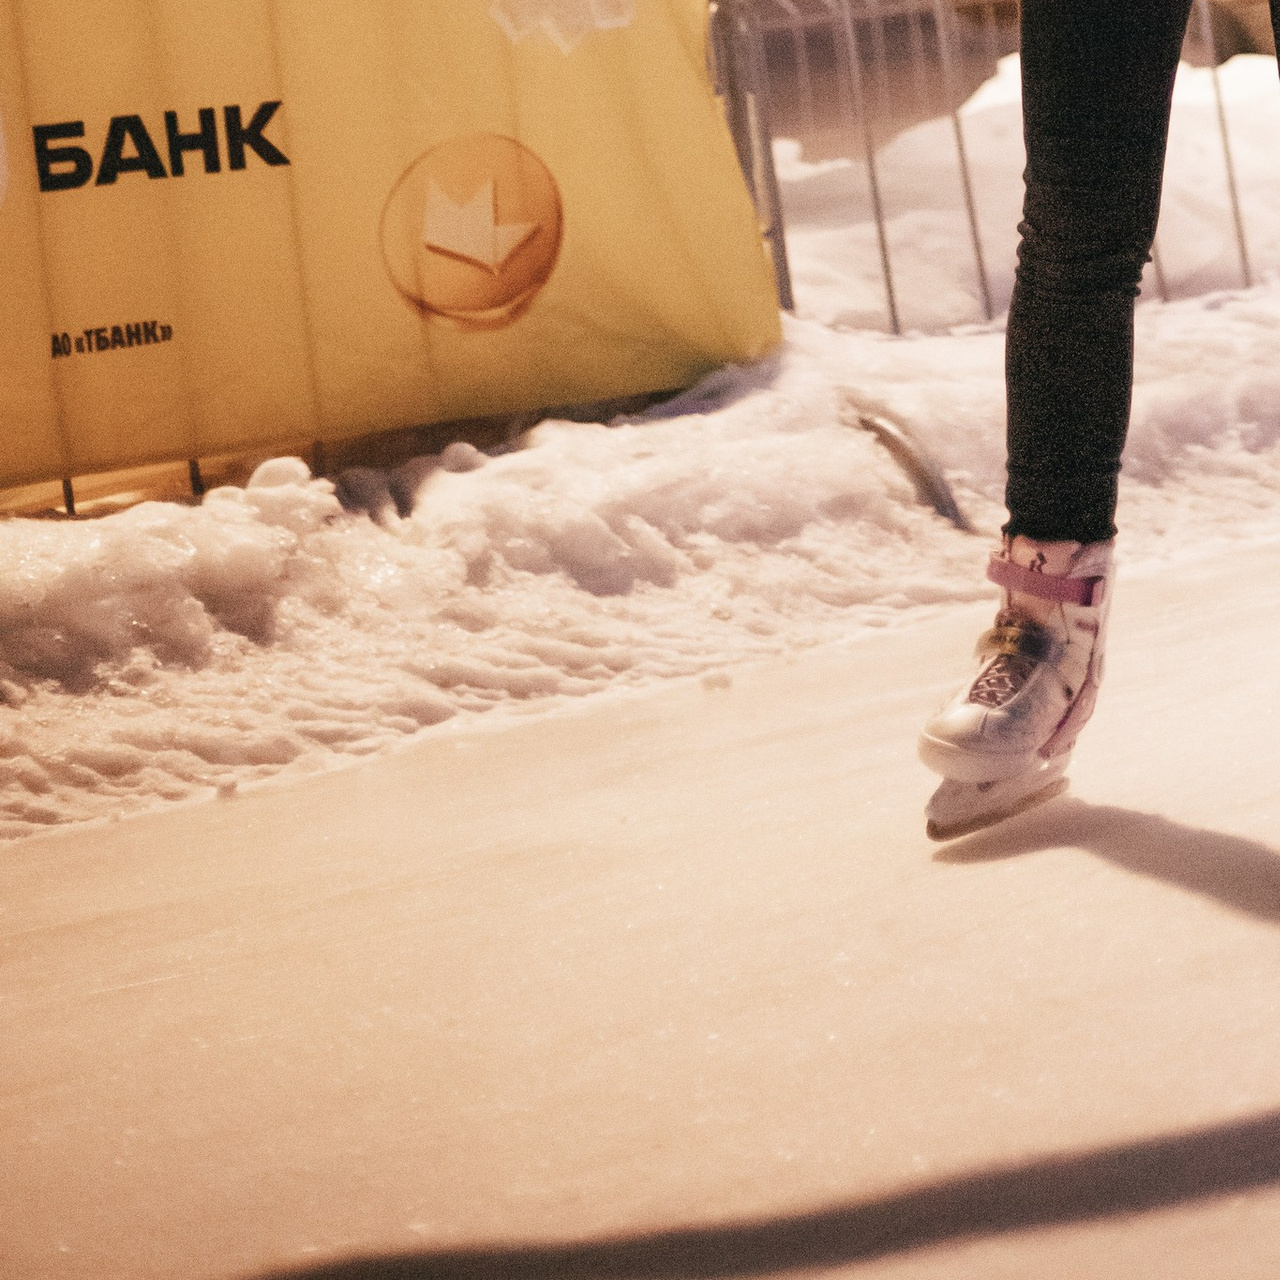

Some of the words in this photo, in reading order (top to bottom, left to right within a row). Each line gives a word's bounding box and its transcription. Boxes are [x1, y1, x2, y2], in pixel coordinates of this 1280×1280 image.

[32, 100, 291, 192] БАНК
[51, 331, 72, 359] АО
[75, 320, 173, 353] «ТБАНК»
